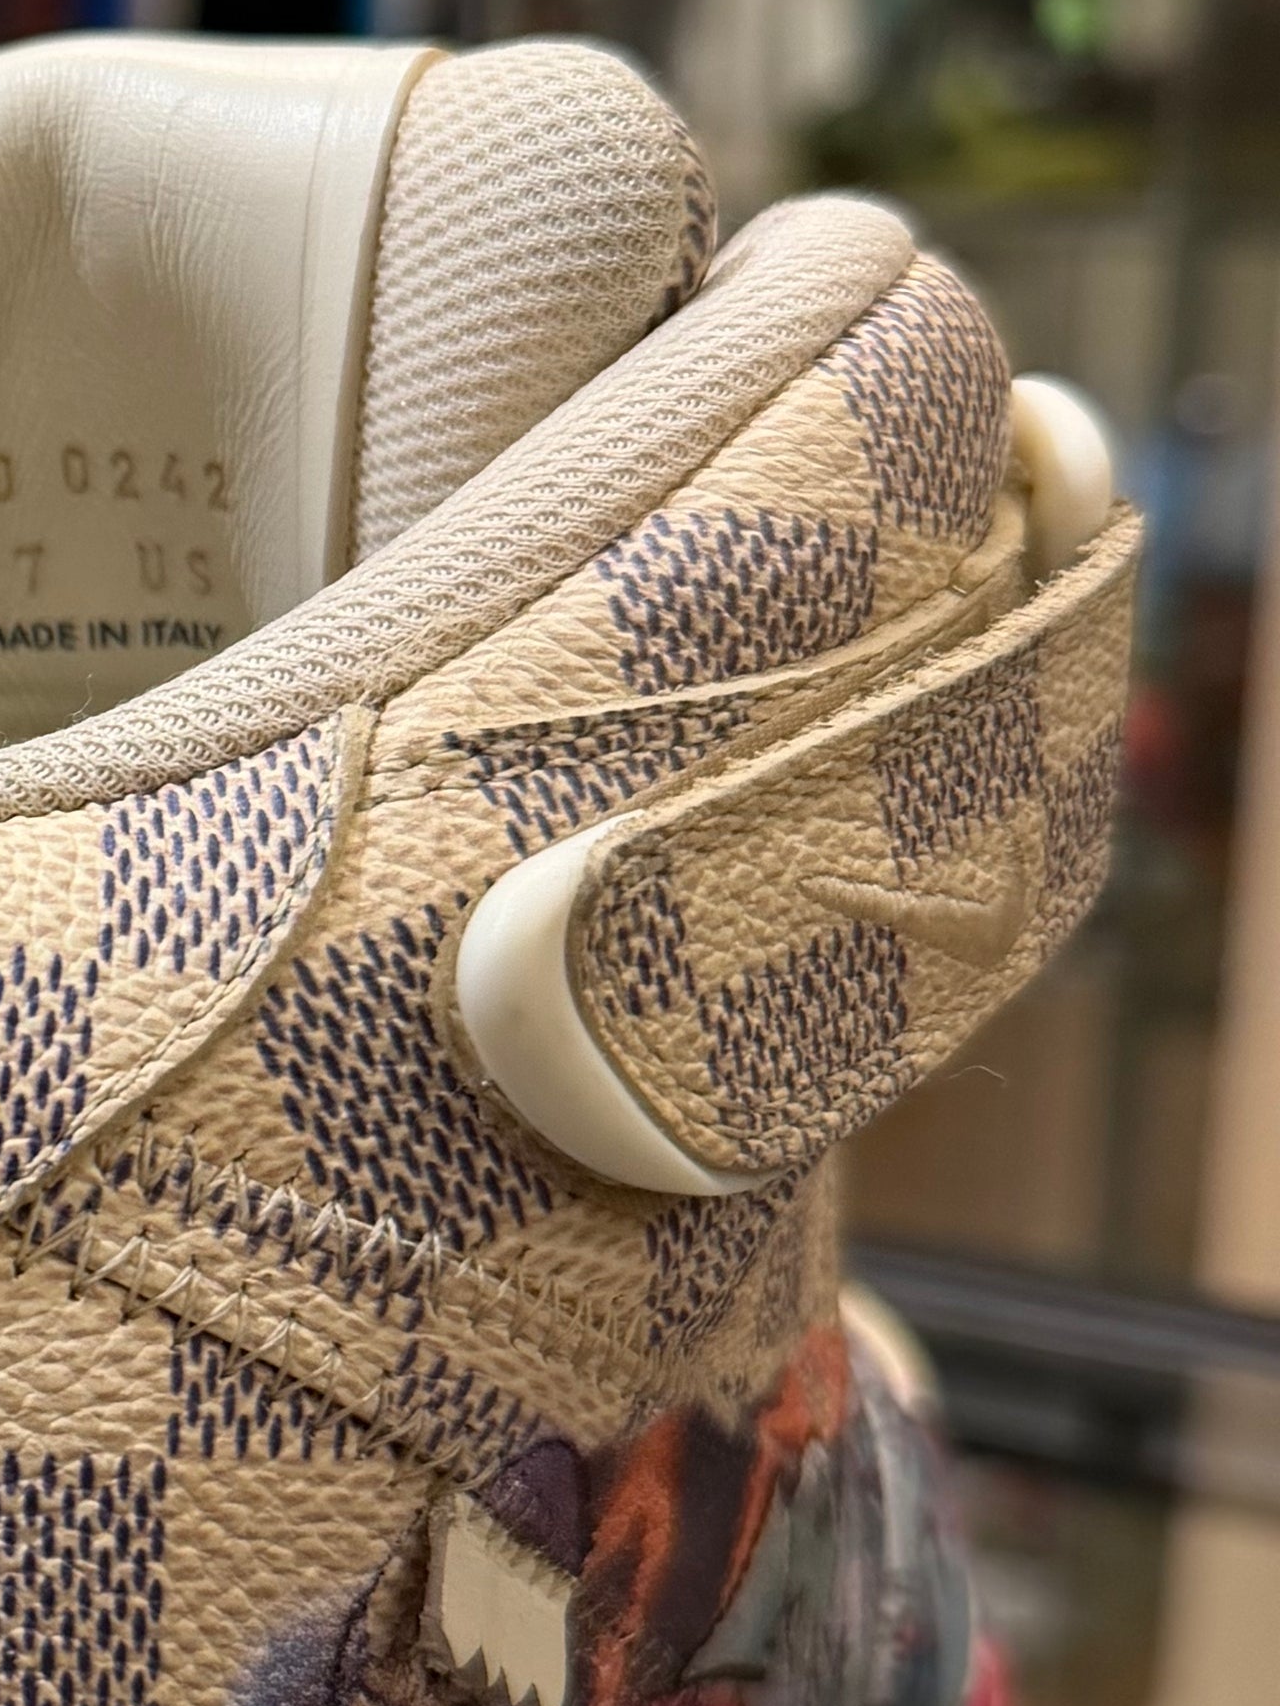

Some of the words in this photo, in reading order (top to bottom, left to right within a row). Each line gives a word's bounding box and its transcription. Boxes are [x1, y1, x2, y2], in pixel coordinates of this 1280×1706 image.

[62, 445, 232, 511] 0242
[13, 541, 46, 595] 7
[136, 541, 214, 596] US
[87, 618, 132, 650] IN
[140, 618, 226, 651] ITALY
